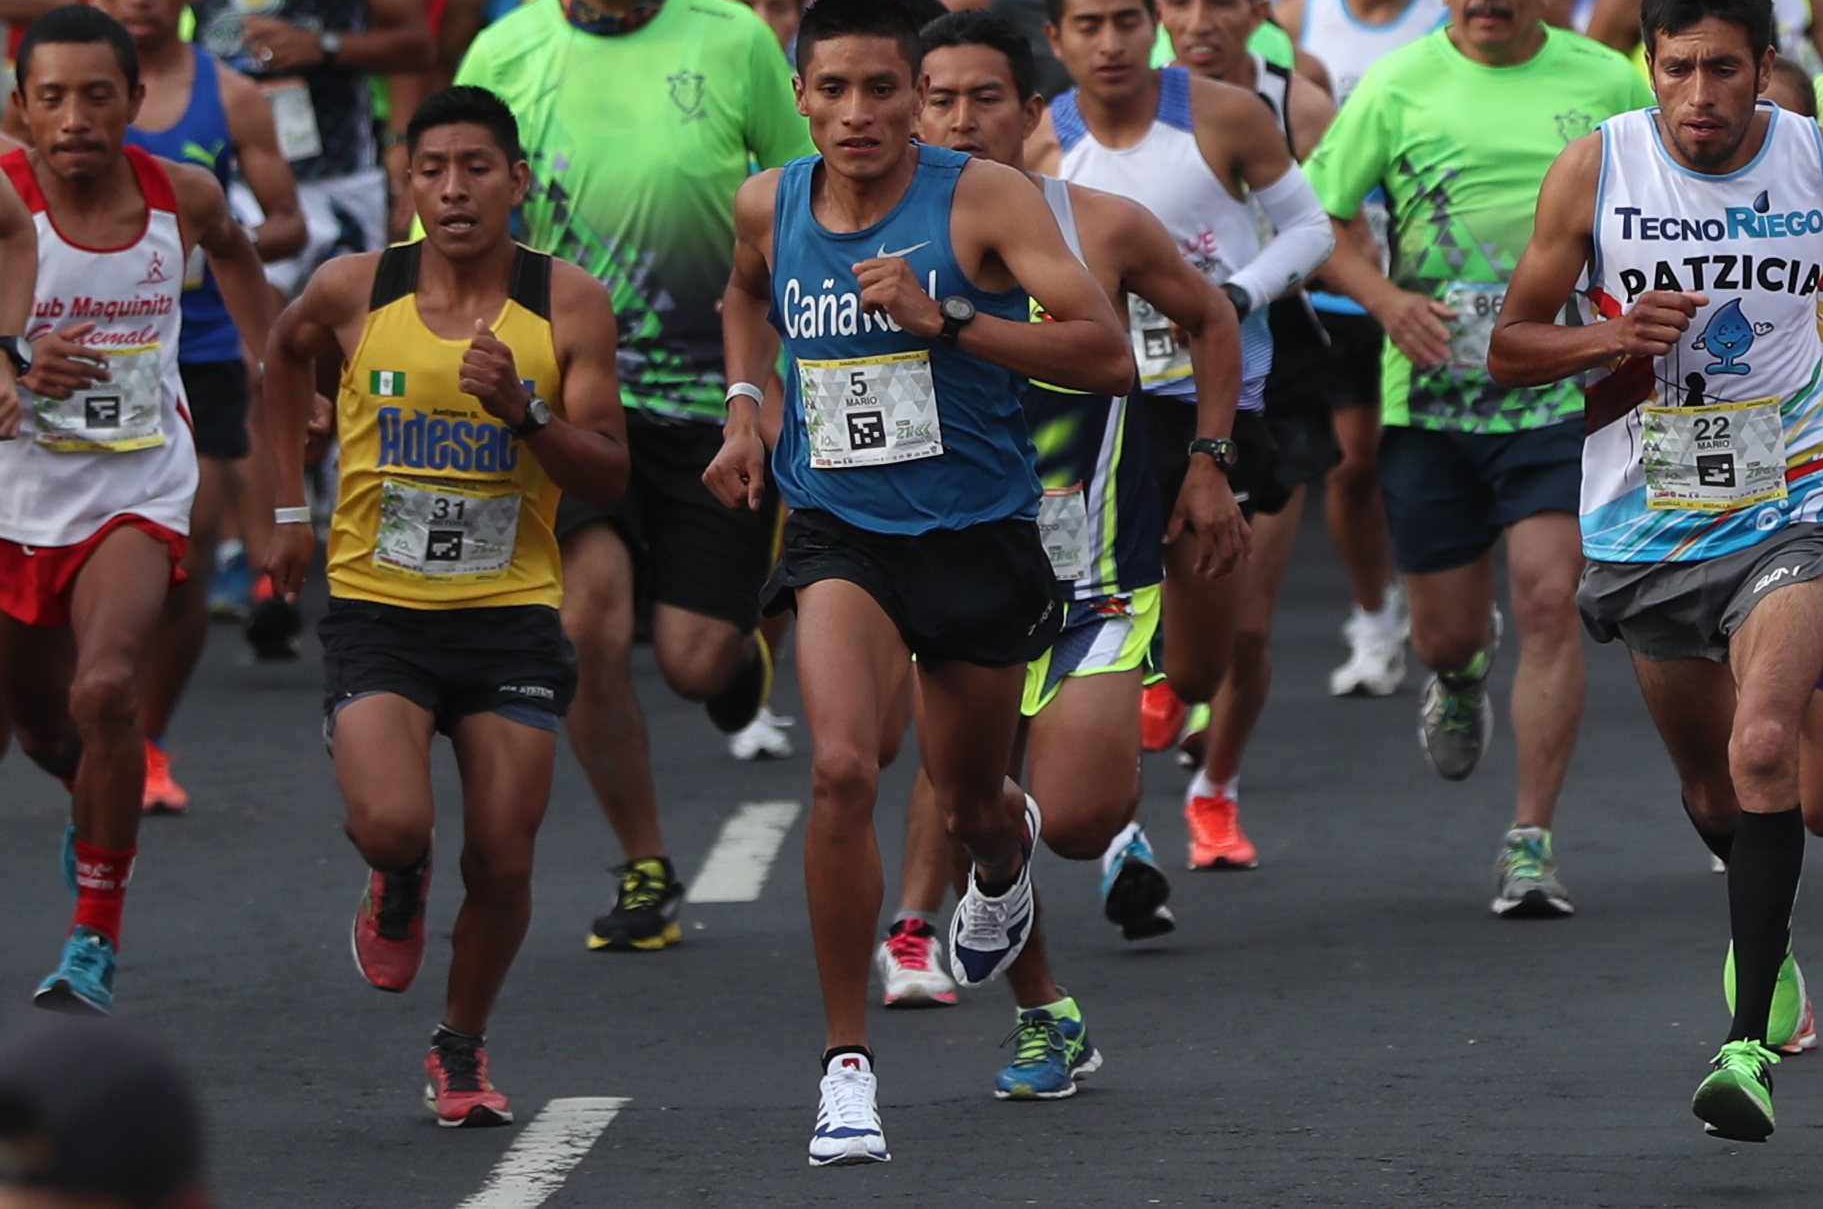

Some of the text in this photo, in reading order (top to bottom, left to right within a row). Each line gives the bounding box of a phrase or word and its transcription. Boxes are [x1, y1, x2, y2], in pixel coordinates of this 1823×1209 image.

[1619, 255, 1821, 304] PATZICIA
[70, 293, 173, 324] Maquinita
[850, 371, 868, 397] 5
[846, 396, 877, 407] MARIO
[1694, 416, 1731, 441] 22
[1697, 440, 1730, 450] MARIO
[430, 498, 466, 522] 31
